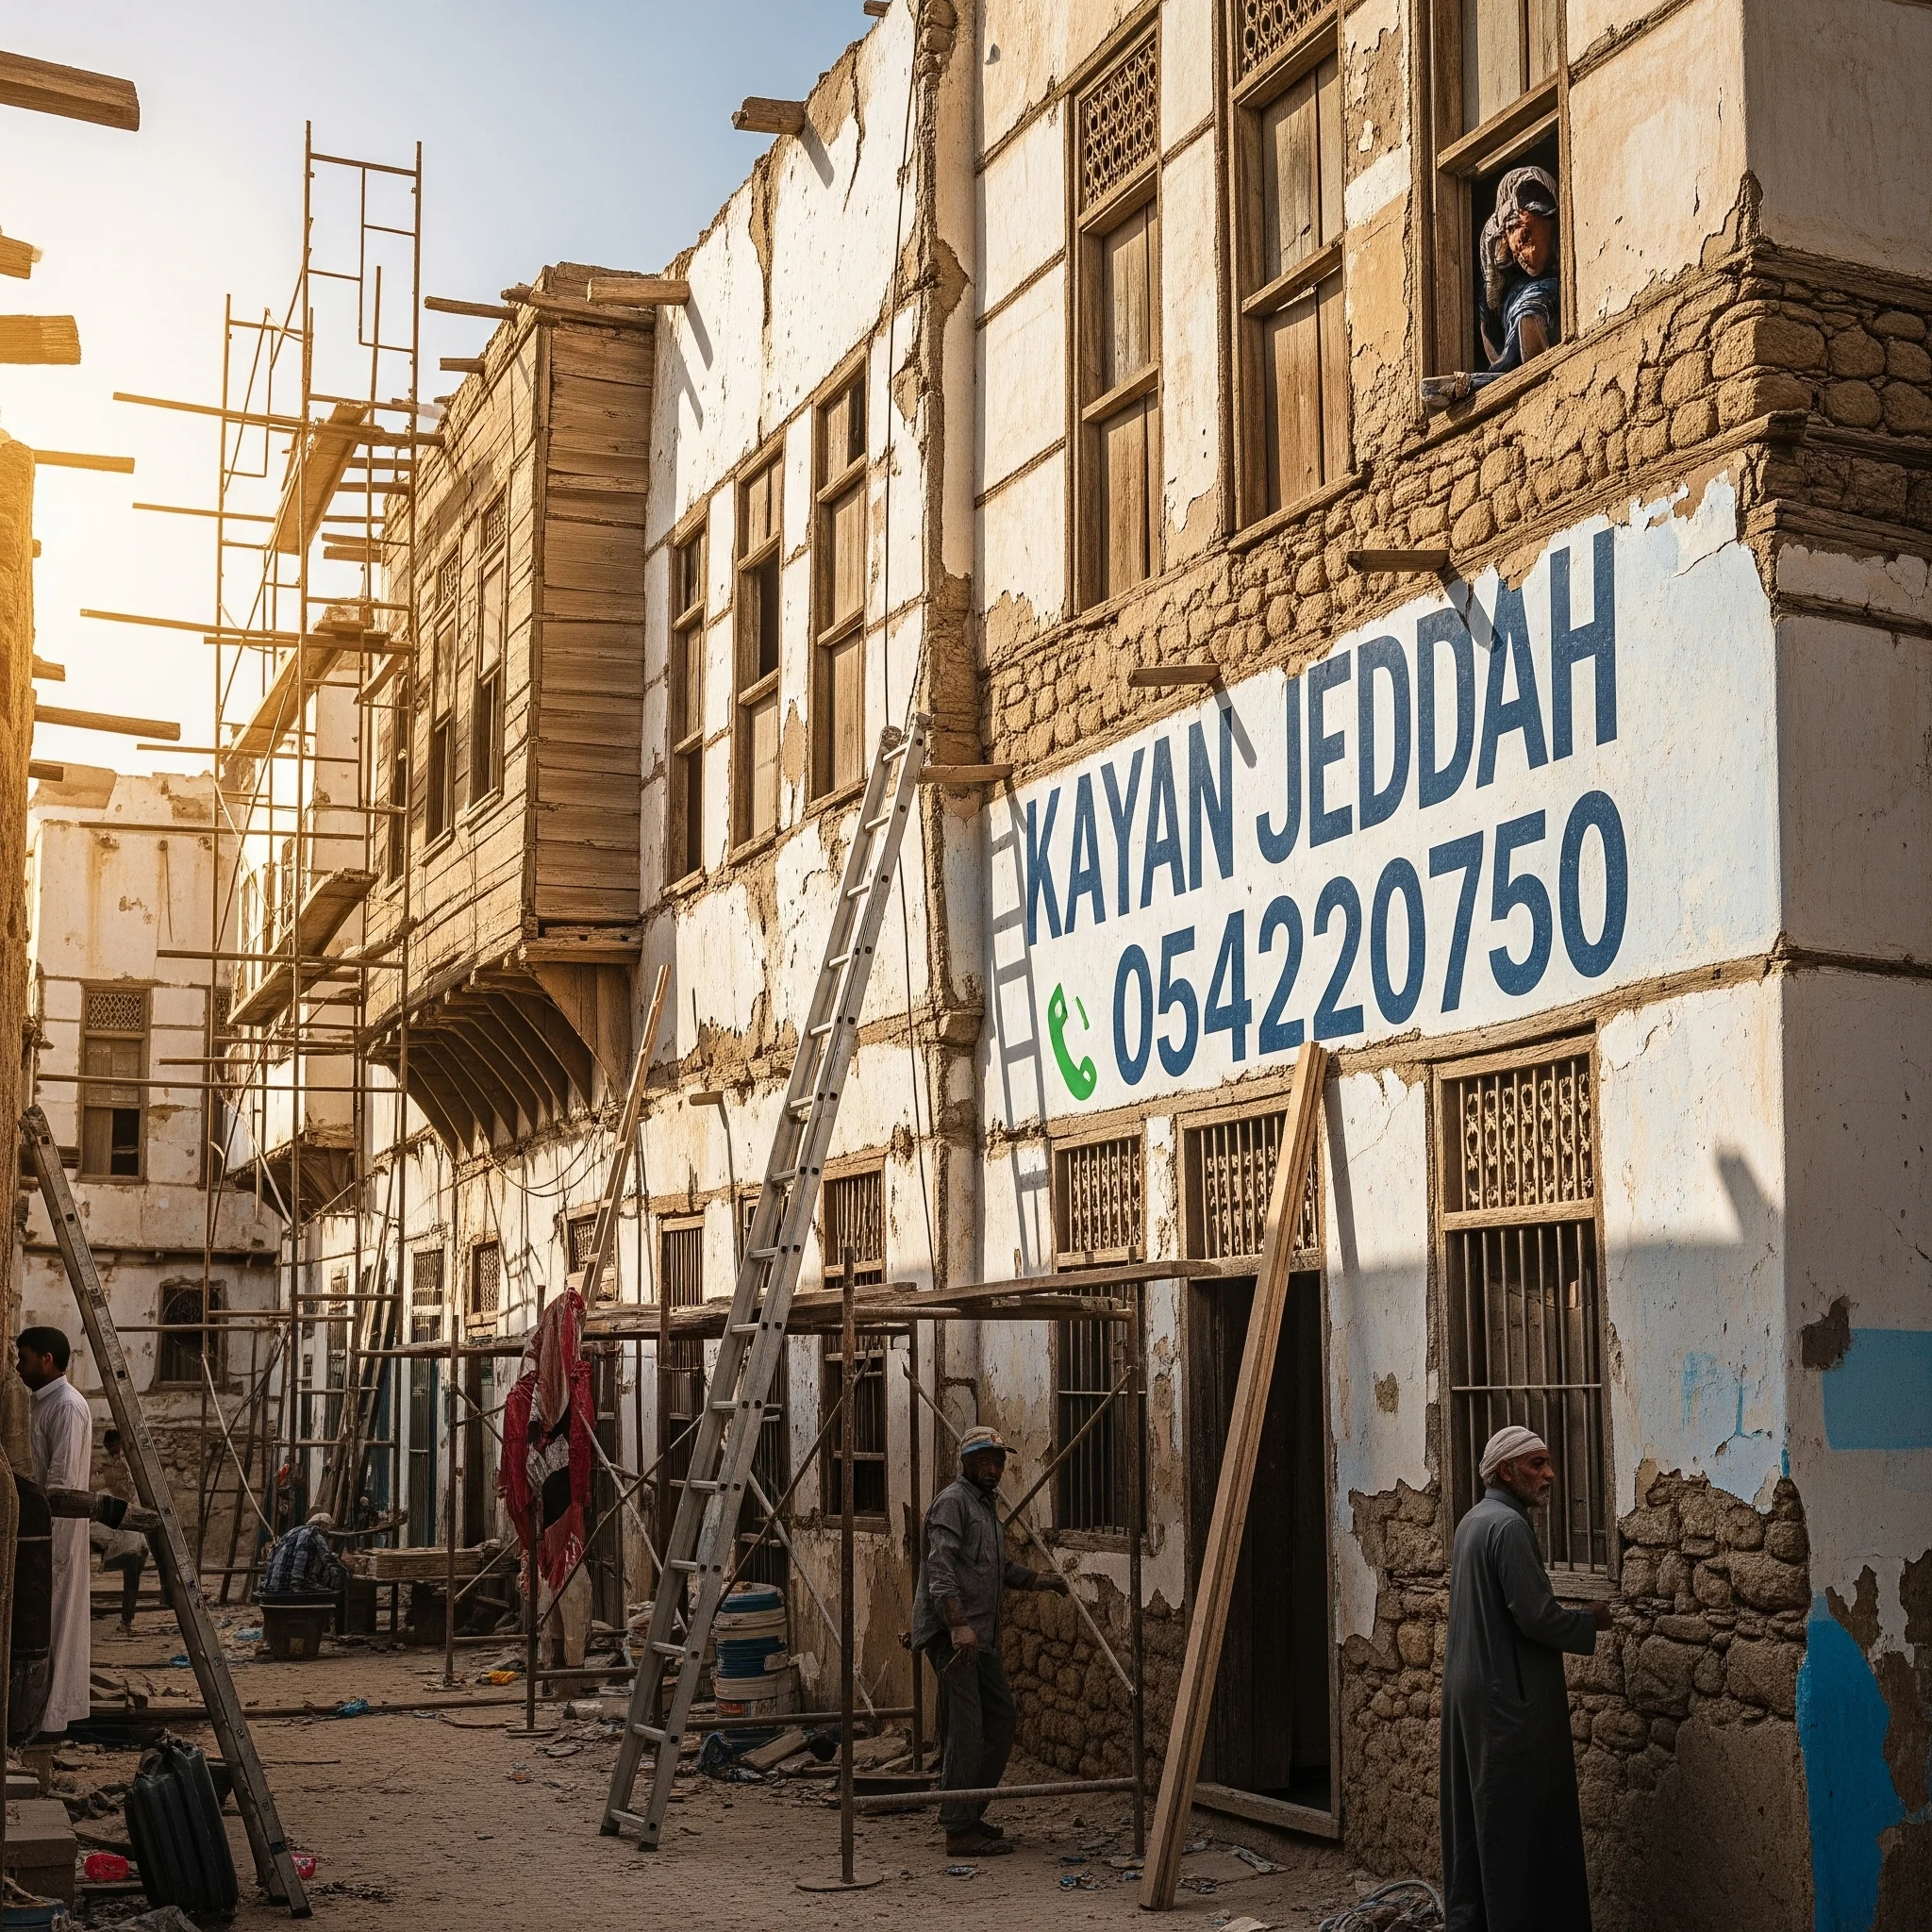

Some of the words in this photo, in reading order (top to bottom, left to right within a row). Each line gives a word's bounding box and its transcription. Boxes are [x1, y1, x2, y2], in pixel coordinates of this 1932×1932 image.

[1026, 706, 1234, 947] KAYAN
[1257, 527, 1618, 864] JEDDAH
[1112, 791, 1628, 1086] 054220750
